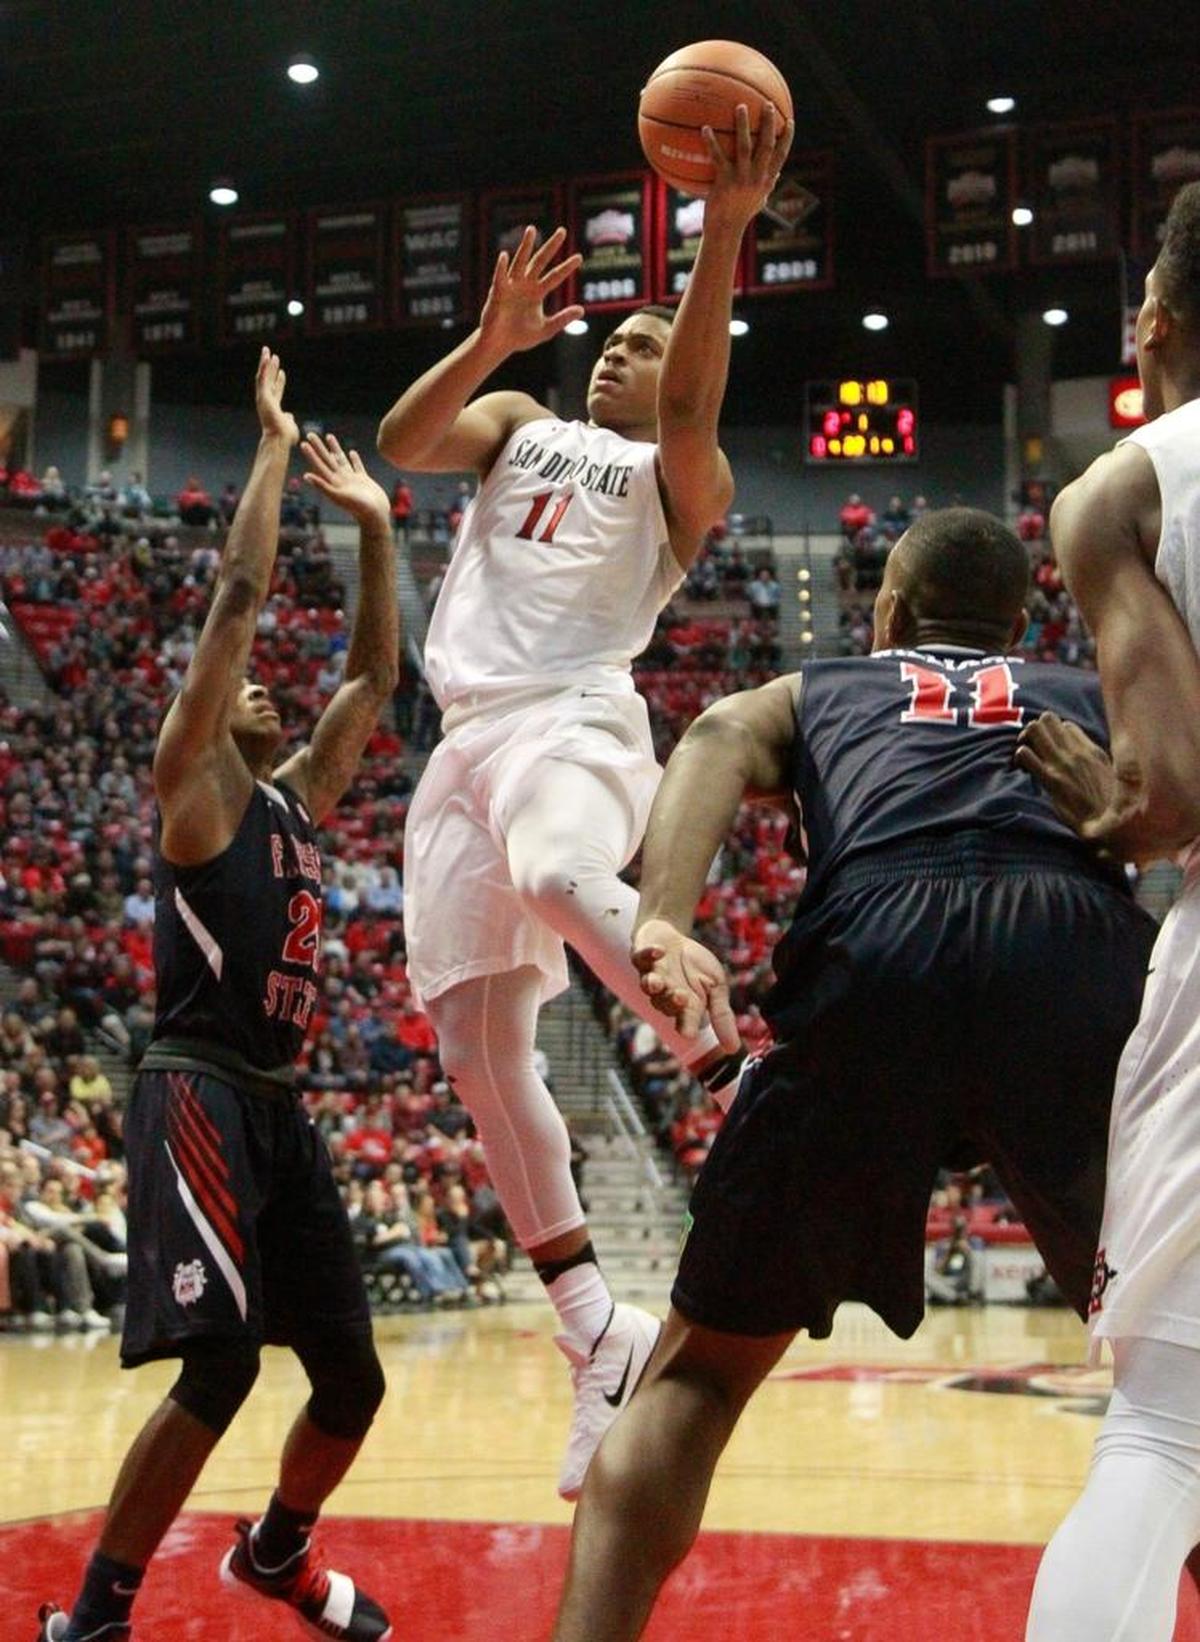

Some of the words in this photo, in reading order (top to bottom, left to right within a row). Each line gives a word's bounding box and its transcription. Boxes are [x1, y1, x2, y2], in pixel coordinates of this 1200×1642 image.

[404, 229, 459, 250] WAC
[508, 439, 545, 470] SAN
[538, 452, 588, 482] DIO
[580, 463, 633, 498] STATE
[515, 490, 574, 544] 11
[900, 660, 1025, 728] 11
[282, 889, 321, 974] 2
